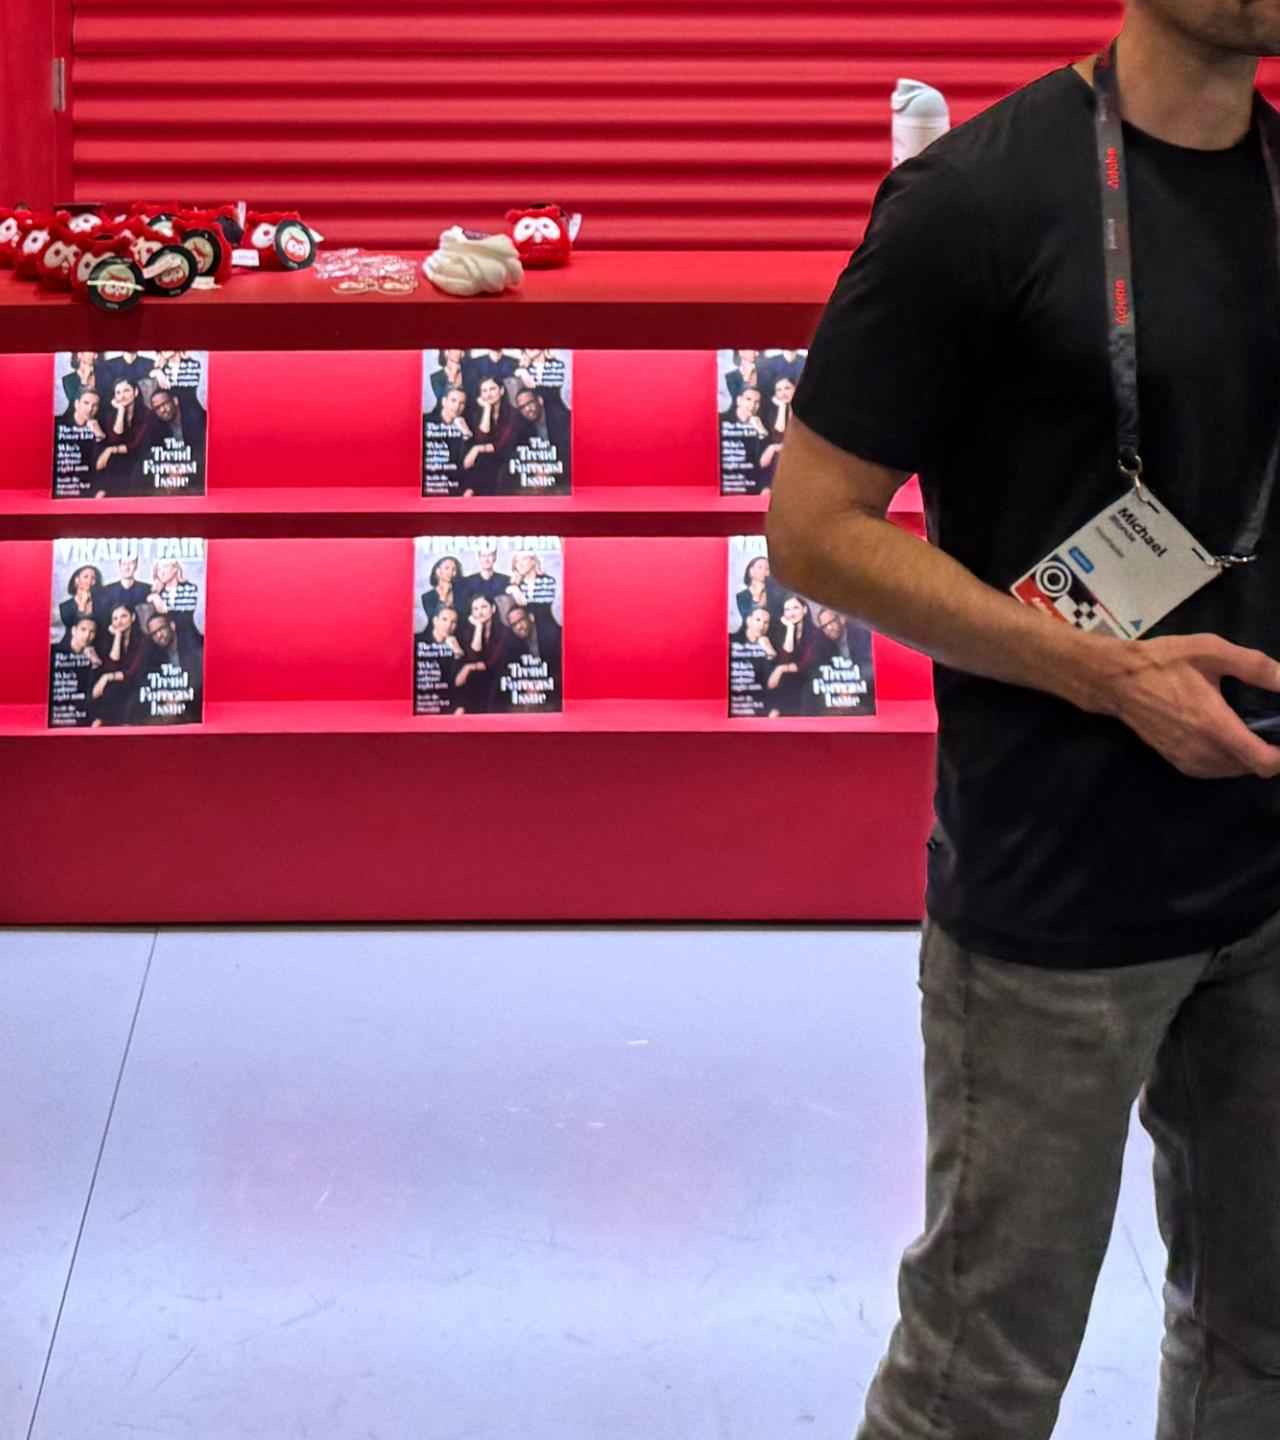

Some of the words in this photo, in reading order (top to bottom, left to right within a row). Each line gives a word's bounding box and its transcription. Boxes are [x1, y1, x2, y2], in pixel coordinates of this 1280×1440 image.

[164, 437, 185, 449] The
[529, 437, 551, 449] The
[151, 444, 191, 461] Trend
[517, 445, 557, 461] Trend
[154, 474, 189, 488] Issue
[520, 473, 556, 488] Issue
[1118, 507, 1168, 558] Michael
[160, 663, 182, 676] The
[508, 663, 548, 679] Trend
[819, 664, 860, 681] Trend
[148, 671, 188, 688] Trend
[511, 691, 547, 706] Issue
[150, 702, 186, 716] Issue
